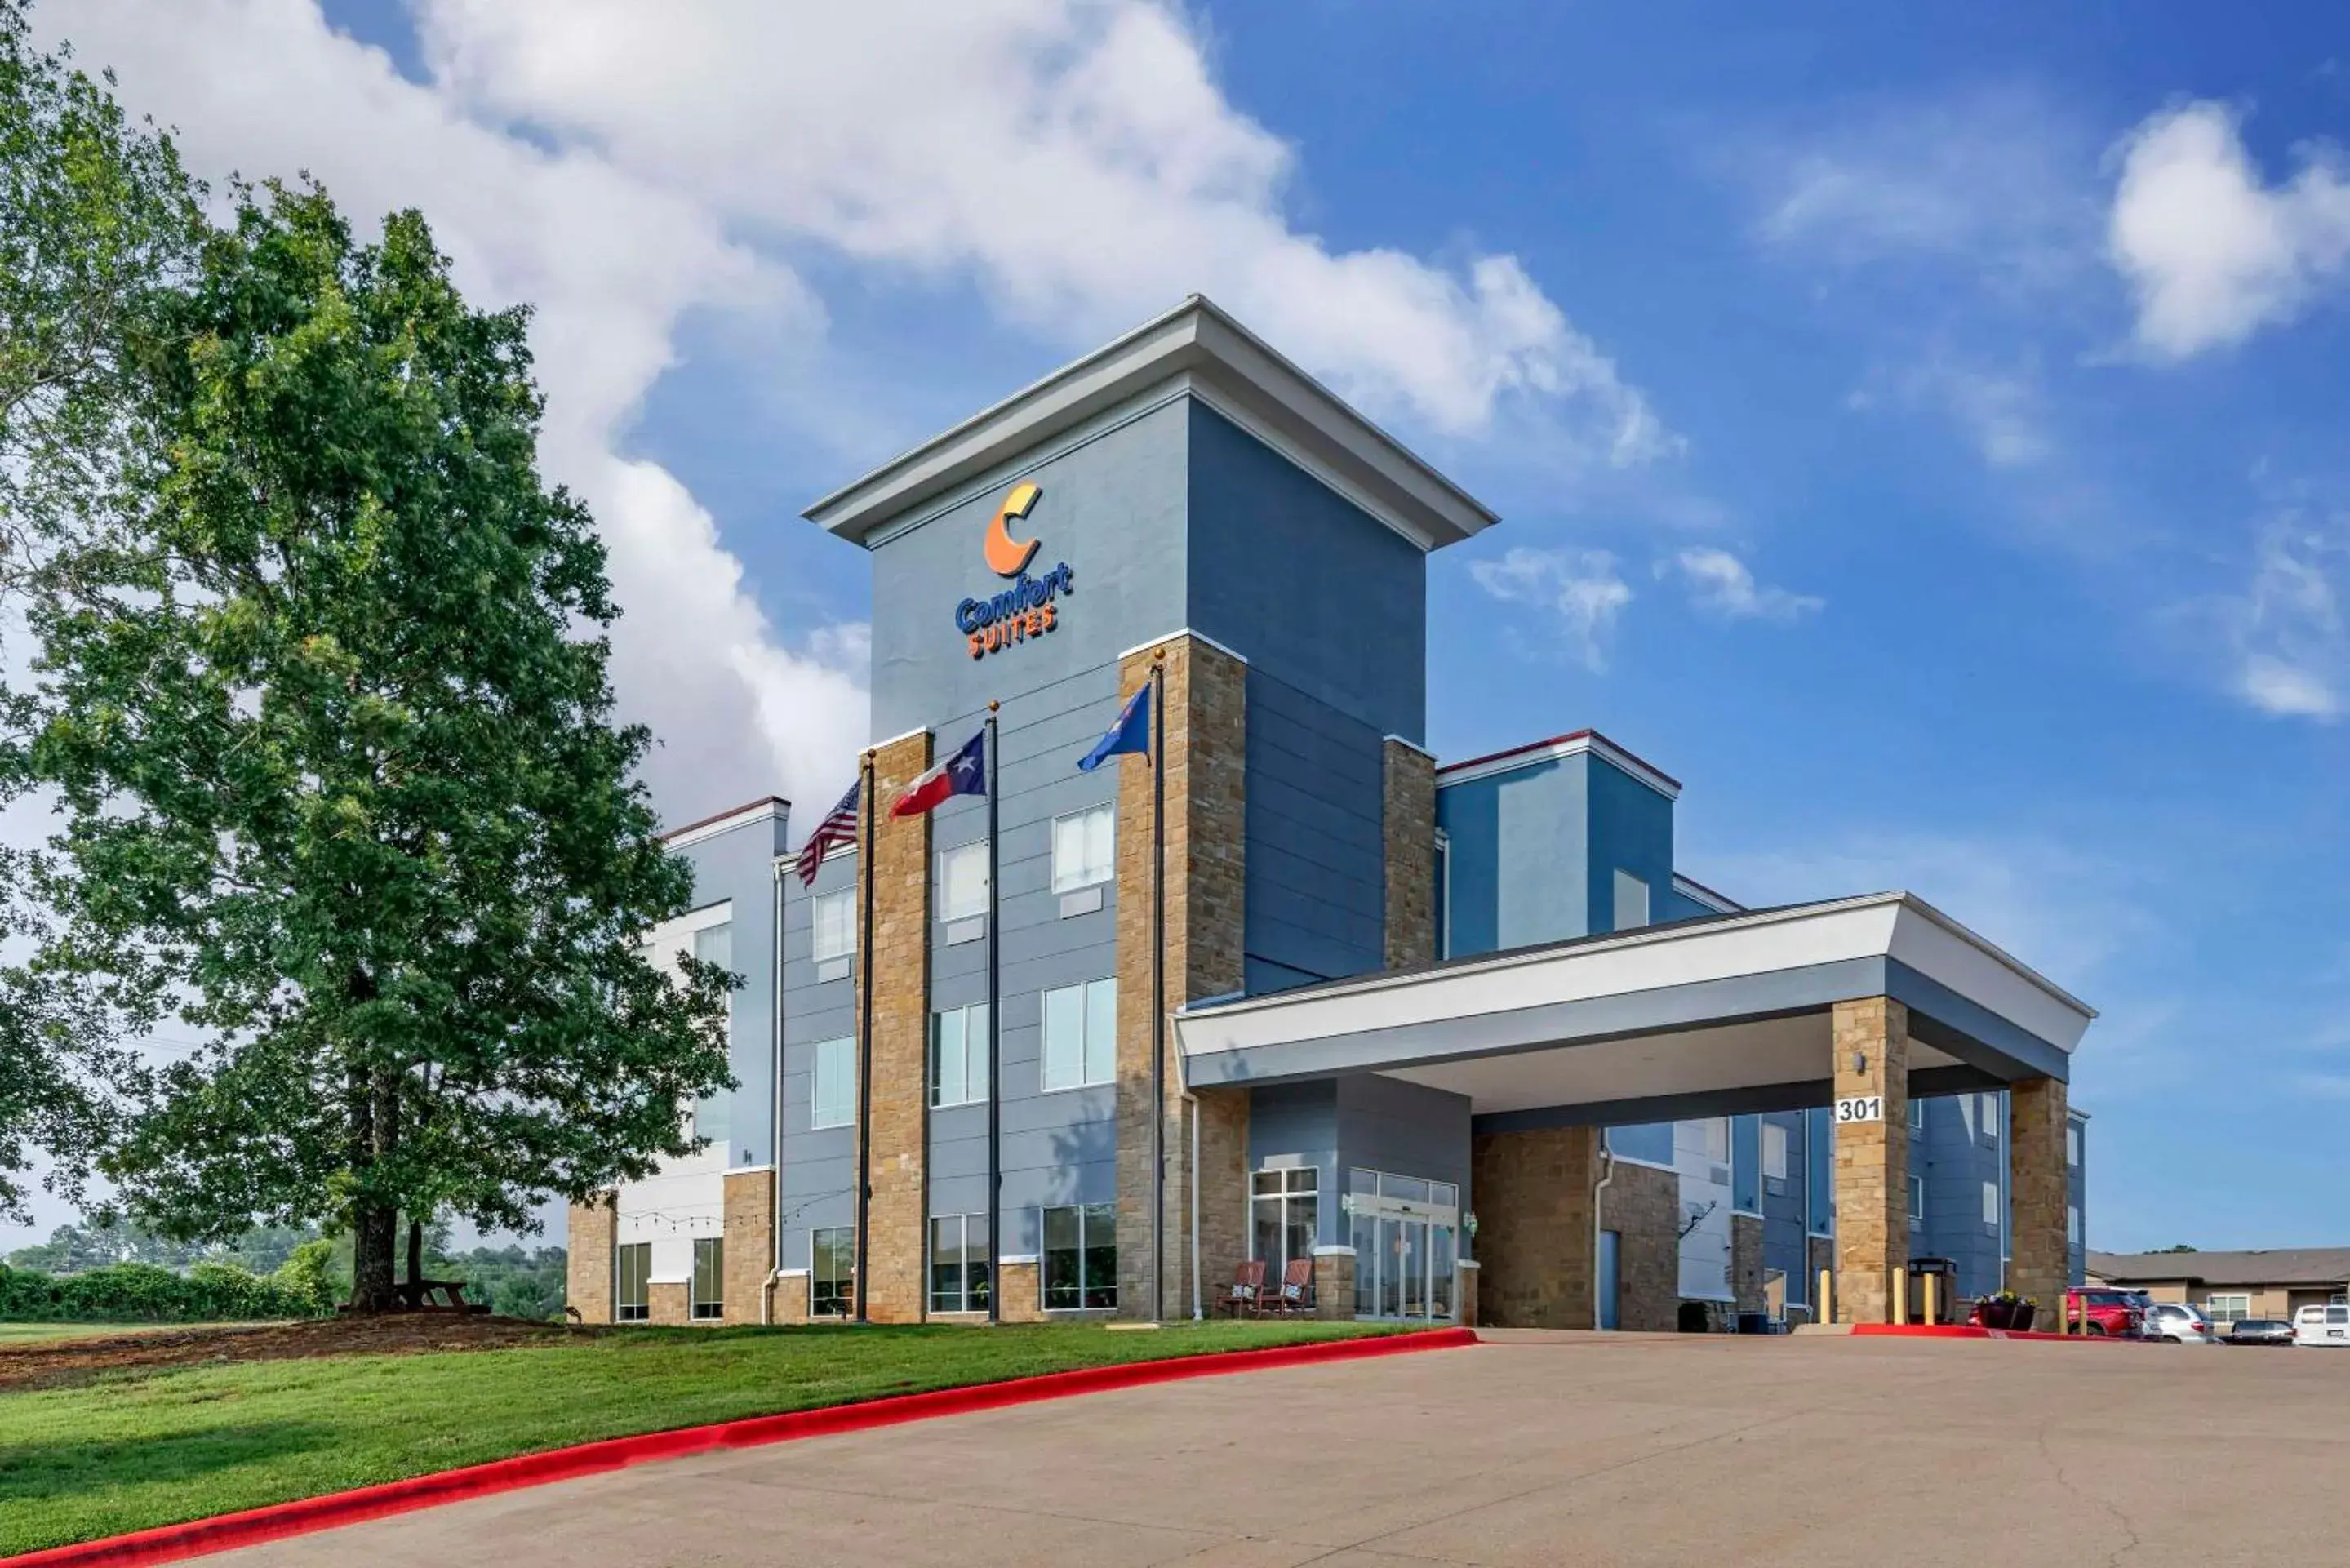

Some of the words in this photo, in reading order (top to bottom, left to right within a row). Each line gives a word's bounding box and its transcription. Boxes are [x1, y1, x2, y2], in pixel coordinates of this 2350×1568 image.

[956, 562, 1072, 634] Comfort
[968, 603, 1057, 659] SUITES
[1840, 1098, 1880, 1121] 301
